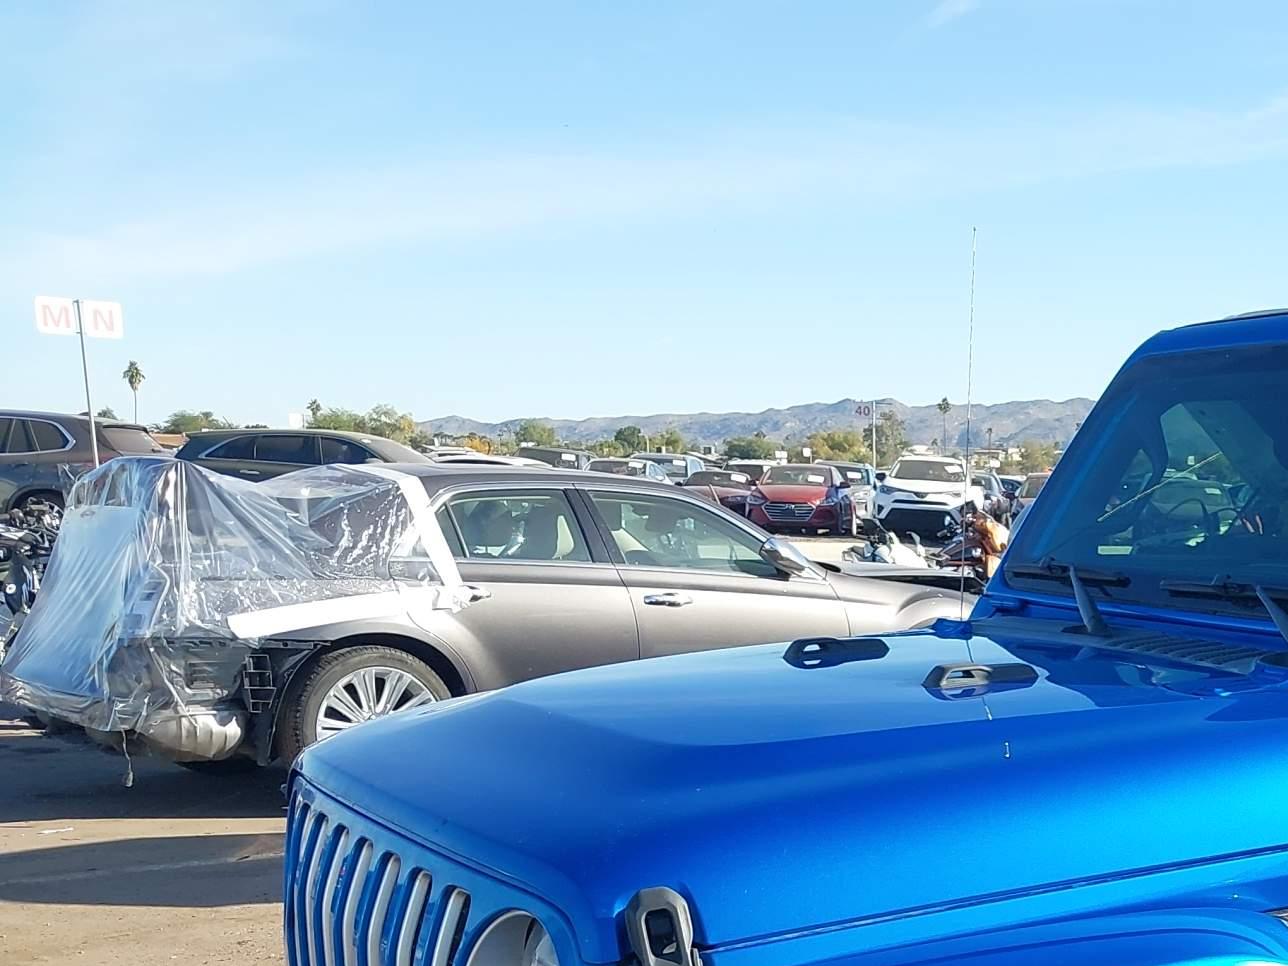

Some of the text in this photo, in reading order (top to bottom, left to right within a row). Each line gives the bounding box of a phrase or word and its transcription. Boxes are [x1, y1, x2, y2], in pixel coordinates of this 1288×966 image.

[42, 305, 114, 330] M N
[855, 405, 871, 416] 40
